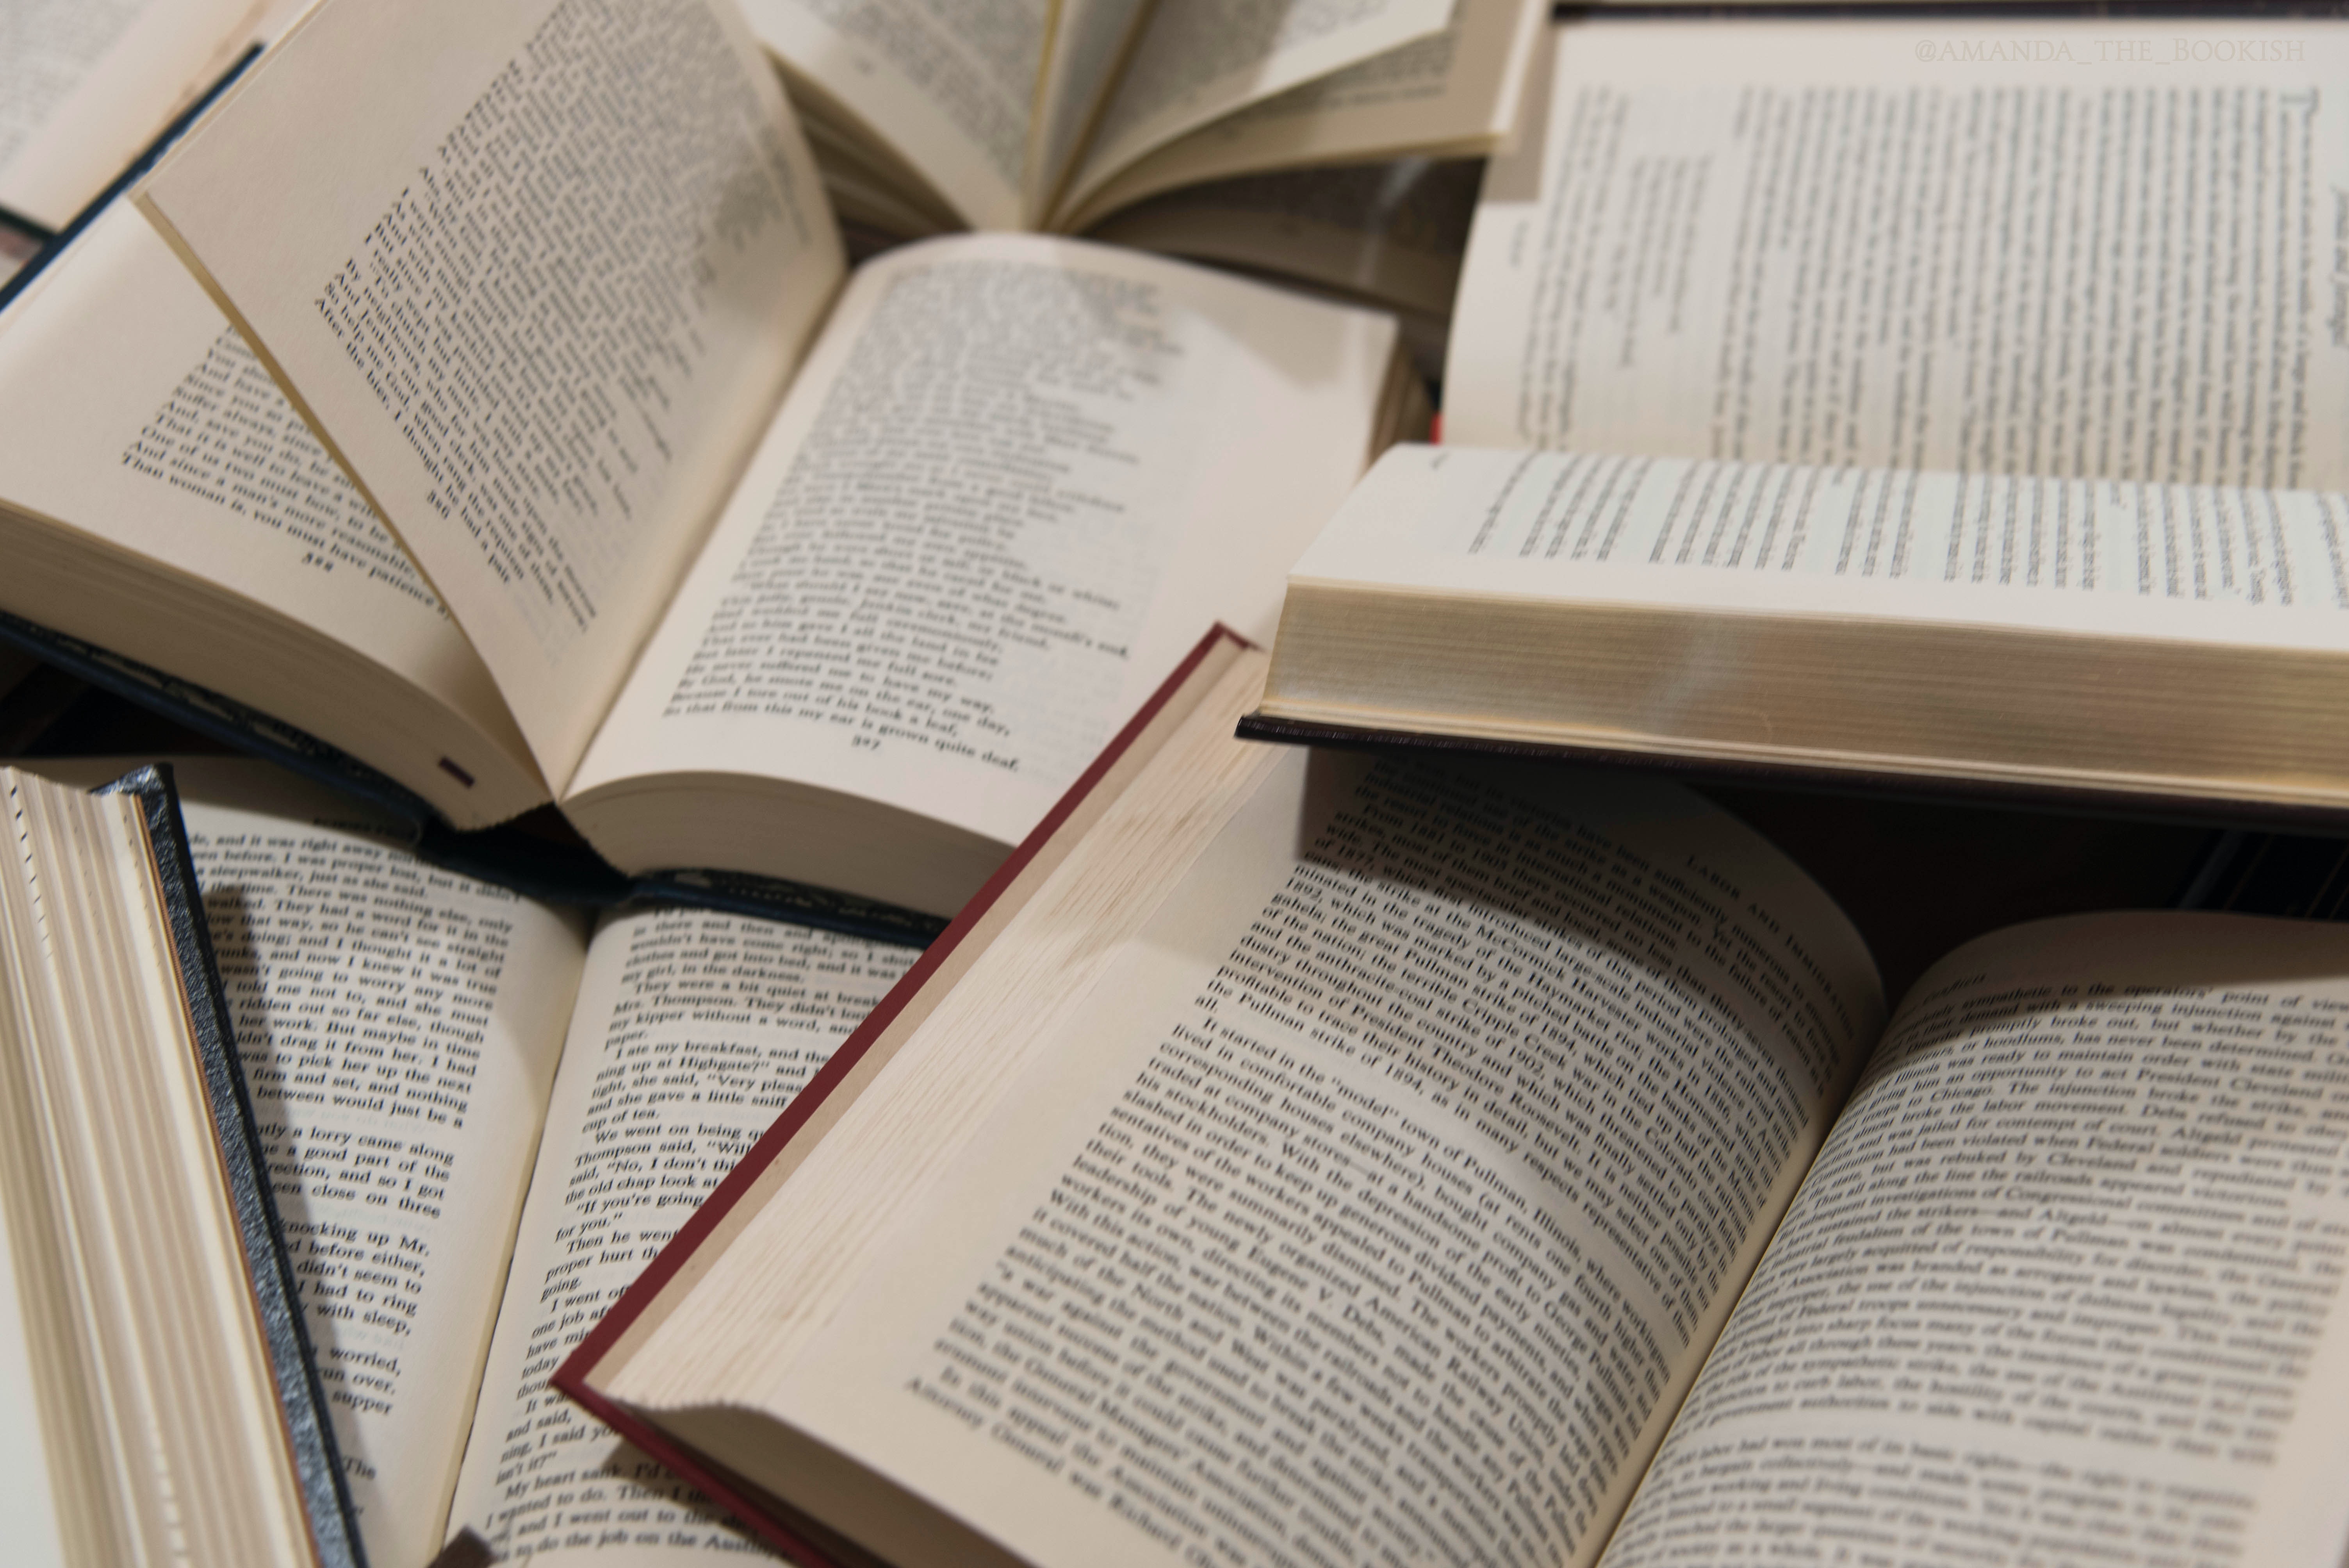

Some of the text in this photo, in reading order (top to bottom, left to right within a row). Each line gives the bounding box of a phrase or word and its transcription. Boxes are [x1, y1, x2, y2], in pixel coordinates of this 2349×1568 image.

[314, 299, 343, 338] After
[346, 342, 364, 368] the
[403, 424, 444, 483] thought
[445, 484, 459, 506] he
[460, 507, 481, 538] had
[169, 458, 210, 479] since
[121, 452, 164, 479] Than
[169, 474, 226, 505] woman
[254, 510, 282, 528] you
[287, 524, 325, 549] must
[330, 543, 367, 568] have
[368, 567, 438, 606] patience
[877, 724, 929, 744] grown
[934, 739, 976, 757] quite
[209, 865, 303, 882] sleepwalker,
[330, 859, 384, 874] proper
[274, 899, 412, 928] They word
[288, 884, 513, 935] There nothing only
[446, 943, 505, 964] straight
[680, 947, 709, 959] and
[710, 951, 738, 965] got
[742, 951, 775, 964] into
[742, 939, 784, 951] come
[358, 976, 493, 1011] worry more
[635, 977, 806, 999] They were quiet
[653, 992, 736, 1008] Thompson.
[635, 1009, 751, 1025] kipper without
[2050, 1015, 2098, 1028] broke
[362, 1028, 417, 1045] maybe
[430, 1021, 484, 1044] though
[280, 1034, 384, 1058] drag from
[684, 1040, 762, 1058] breakfast,
[298, 1054, 471, 1094] pick next
[1160, 1043, 1274, 1105] corresponding
[647, 1090, 787, 1108] gave little sniff
[1220, 1028, 1278, 1060] started
[1299, 1064, 1325, 1083] the
[1400, 1118, 1440, 1149] town
[1172, 1024, 1473, 1196] lived comfortable company houses
[697, 1123, 743, 1141] being
[1476, 1119, 1519, 1153] many
[303, 1147, 389, 1167] good part
[310, 1126, 454, 1167] lorry came along
[575, 1144, 651, 1167] Thompson
[660, 1174, 695, 1188] look
[1123, 1090, 1412, 1255] slashed order generous
[312, 1183, 440, 1219] close three
[601, 1192, 704, 1213] you're going
[1282, 1142, 1320, 1173] With
[1357, 1190, 1440, 1249] depression
[1223, 1210, 1273, 1244] newly
[1228, 1189, 1317, 1245] summarily
[1246, 1174, 1387, 1262] workers appealed
[567, 1236, 603, 1254] Then
[308, 1240, 425, 1278] before either,
[545, 1249, 633, 1282] proper hurt
[296, 1259, 398, 1288] didn't seem
[382, 1294, 417, 1317] ring
[316, 1304, 411, 1336] with sleep,
[329, 1347, 401, 1377] worried,
[522, 1356, 560, 1380] today
